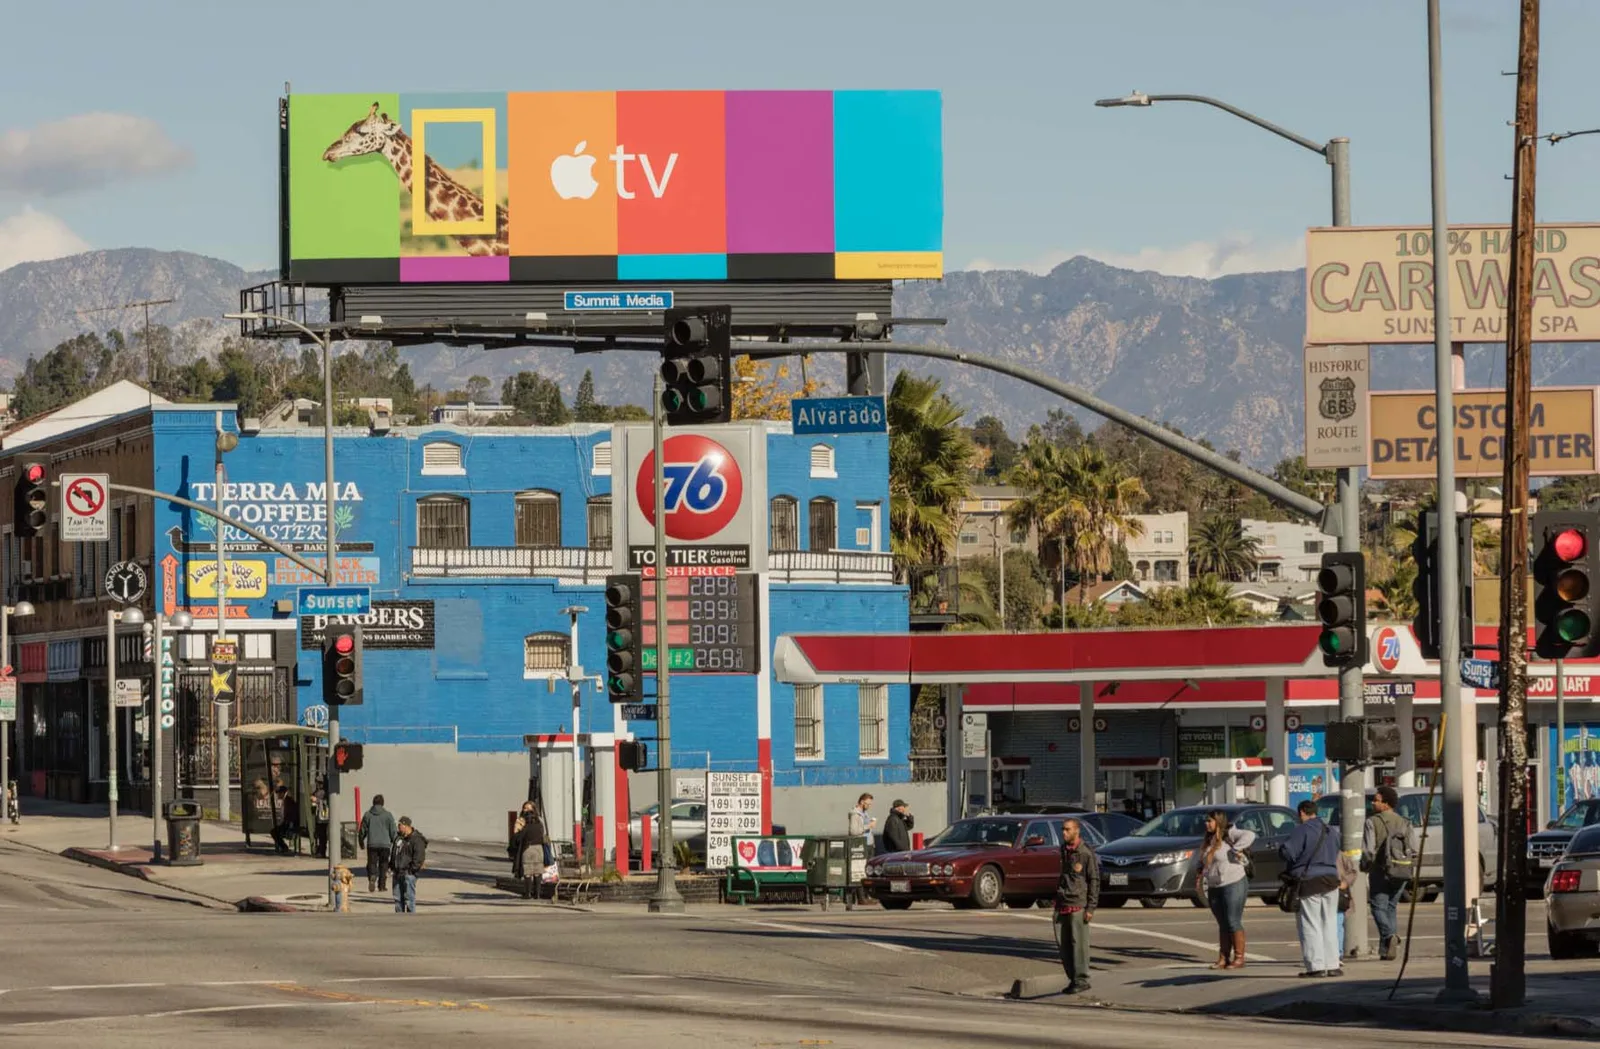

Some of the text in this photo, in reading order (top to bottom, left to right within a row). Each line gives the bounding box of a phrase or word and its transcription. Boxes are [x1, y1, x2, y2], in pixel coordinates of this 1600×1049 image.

[608, 144, 679, 200] tv
[1395, 229, 1567, 256] 10% HND
[1310, 261, 1434, 312] CAR
[574, 295, 664, 307] Summit Media
[1384, 316, 1466, 334] SUNT
[1539, 316, 1579, 333] SPA
[1309, 360, 1365, 373] HISTORIC
[1327, 400, 1348, 415] 66
[798, 406, 881, 426] Alvarado
[1417, 403, 1545, 430] CSTOM
[1317, 427, 1358, 439] ROUTE
[651, 453, 727, 514] 76
[304, 482, 363, 501] MIA
[224, 504, 329, 523] COFFEE
[633, 550, 667, 564] TO
[672, 550, 708, 564] TIER
[711, 556, 747, 564] Gasoline
[276, 572, 313, 585] FILM
[643, 567, 735, 576] CSH PRICE
[235, 576, 262, 590] shop
[306, 594, 362, 609] Sunset
[691, 601, 728, 620] 2.99
[692, 625, 728, 644] 3.09
[696, 648, 734, 668] 2.69
[161, 636, 175, 728] TATTOO
[1364, 684, 1391, 695] SUNSET
[712, 774, 749, 782] SUNSET
[1288, 783, 1310, 793] SCENE
[739, 799, 756, 809] 199
